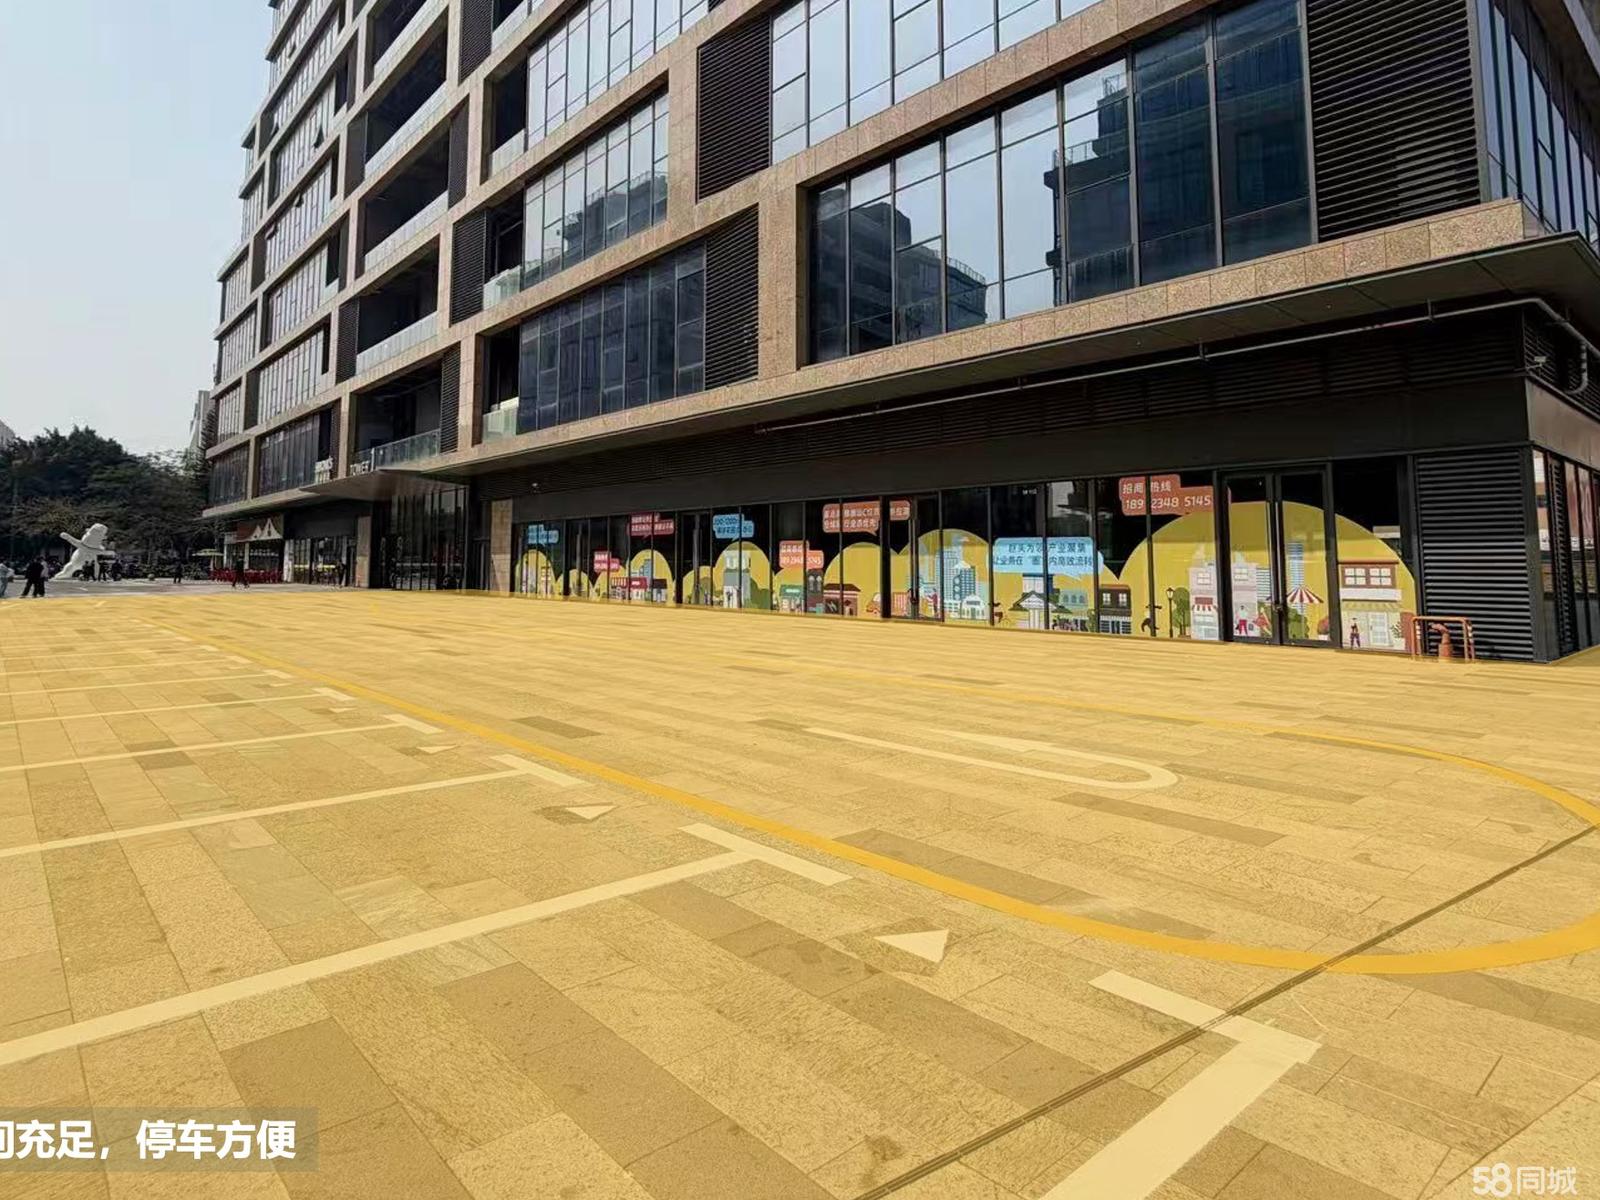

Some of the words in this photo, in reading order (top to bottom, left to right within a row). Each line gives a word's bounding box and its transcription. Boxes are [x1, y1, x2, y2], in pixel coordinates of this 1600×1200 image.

[1126, 498, 1144, 510] 189
[1151, 497, 1180, 509] 2348
[1184, 494, 1211, 507] 5145
